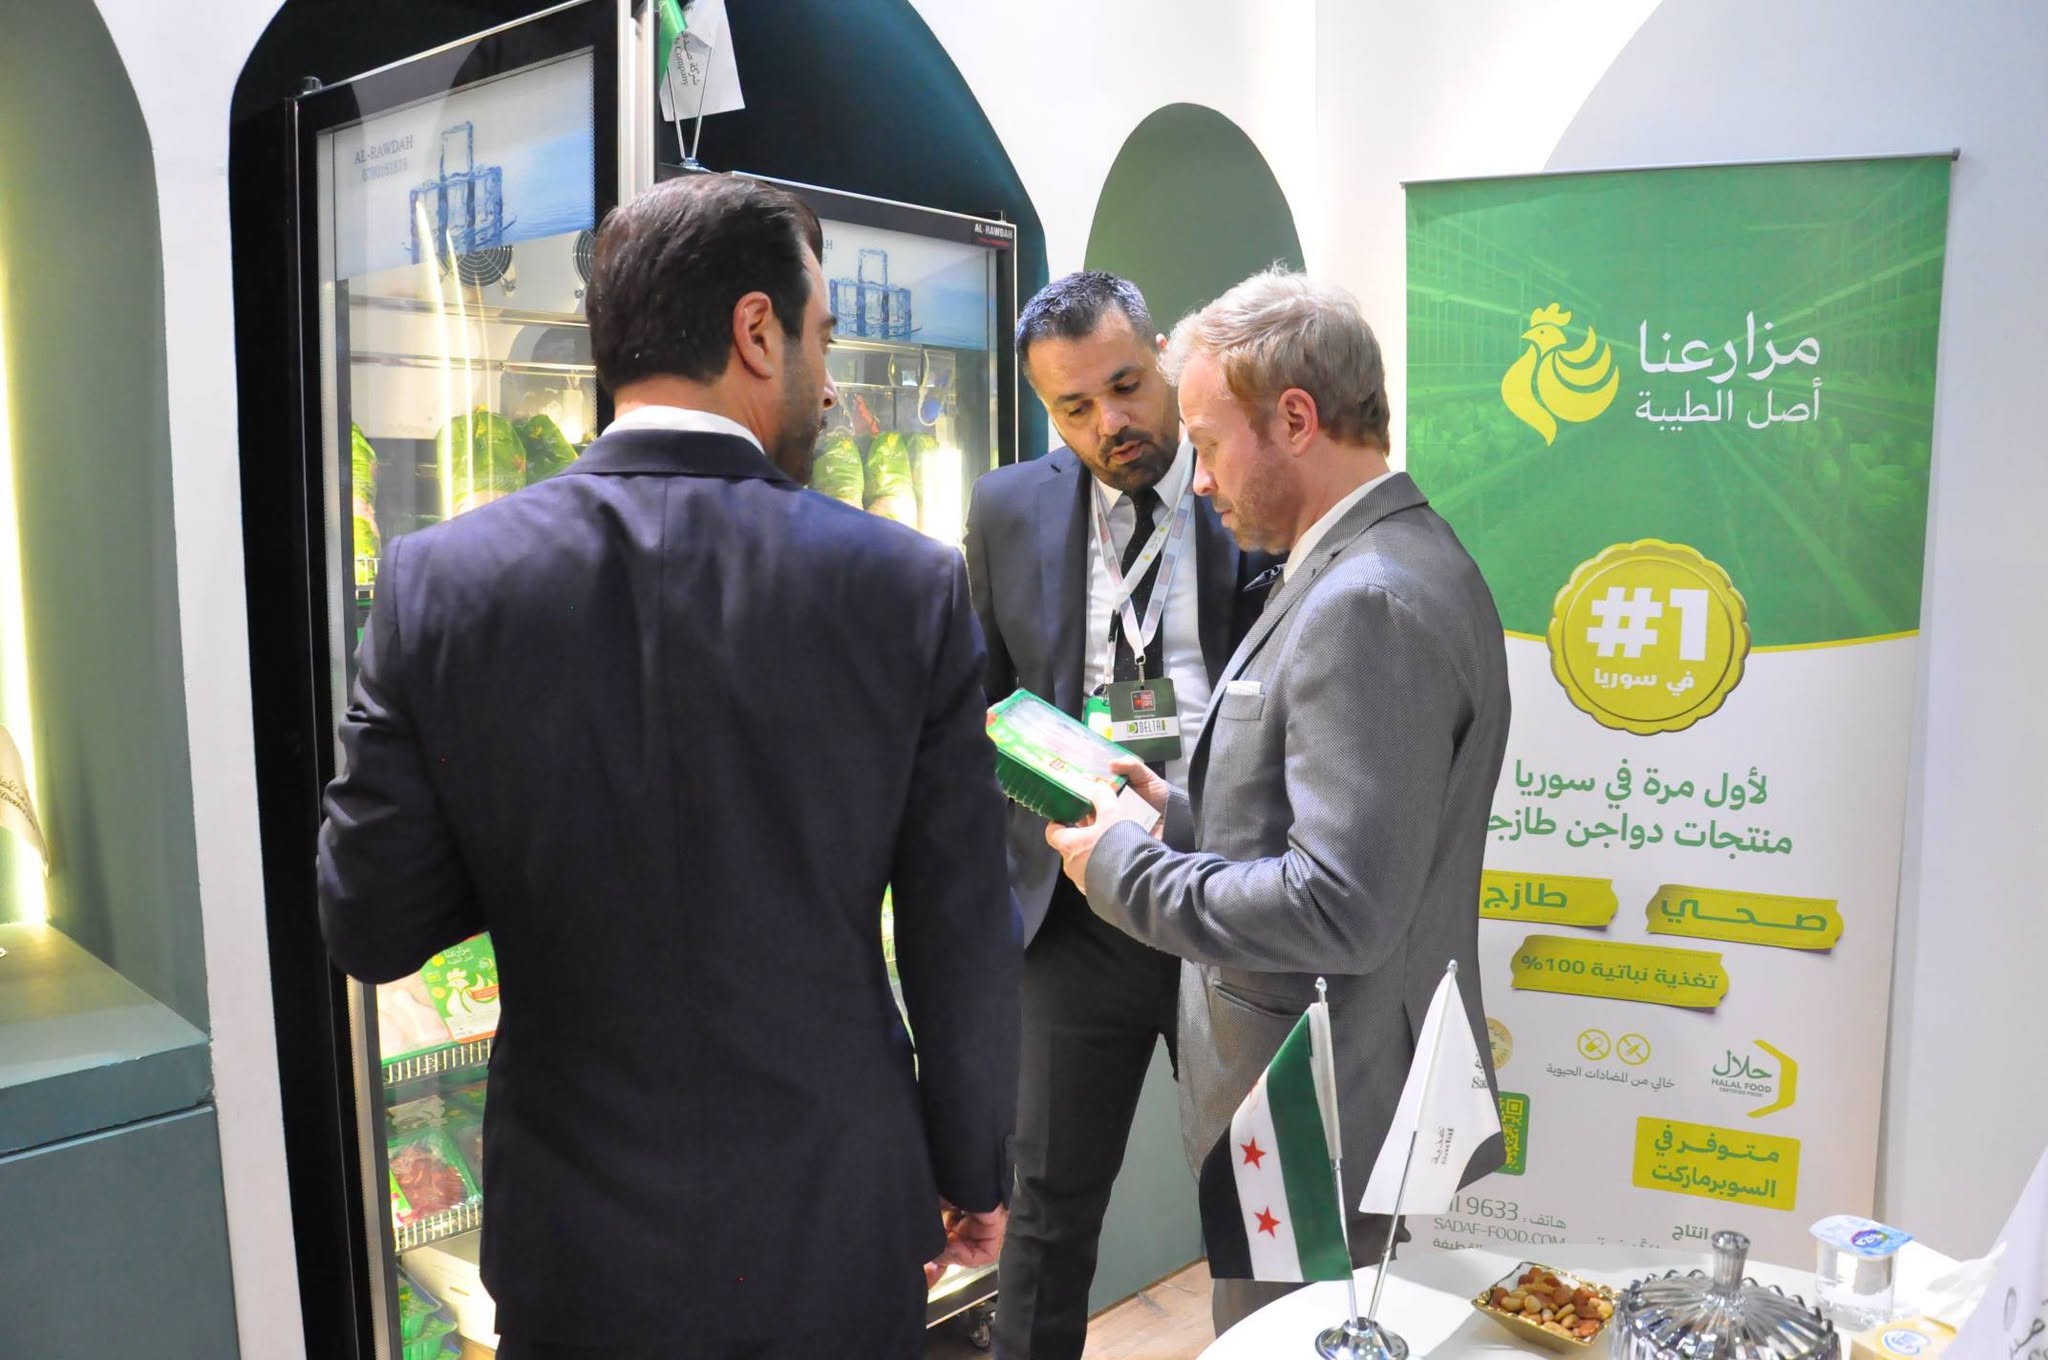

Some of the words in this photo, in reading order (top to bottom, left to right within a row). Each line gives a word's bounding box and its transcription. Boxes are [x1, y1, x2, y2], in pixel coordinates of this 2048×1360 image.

[674, 46, 689, 86] Company
[353, 134, 414, 165] AL-RAWDAH
[1639, 311, 1821, 384] مزارعنا
[1634, 389, 1734, 432] الطيبة
[1746, 377, 1823, 429] أصل
[1586, 586, 1709, 662] #1
[1593, 667, 1658, 689] سوريا
[1666, 670, 1695, 697] في
[1138, 720, 1162, 734] DELTA
[1515, 759, 1596, 799] سوريا
[1605, 758, 1633, 810] في
[1642, 767, 1695, 805] مرة
[1703, 766, 1769, 811] لأول
[1487, 806, 1557, 842] طازج
[1565, 812, 1664, 850] دواجن
[1673, 819, 1793, 860] منتجات
[1483, 881, 1569, 912] طازج
[1660, 897, 1828, 933] صحي
[1590, 960, 1649, 984] نباتية
[1654, 968, 1717, 991] تغذية
[1545, 1063, 1582, 1078] الحيوية
[1584, 1069, 1629, 1084] المضادات
[1712, 1049, 1774, 1079] حلال
[1630, 1078, 1649, 1087] من
[1650, 1077, 1676, 1093] خالي
[1711, 1078, 1743, 1090] HALAL
[1744, 1083, 1772, 1094] FOOD
[1654, 1124, 1673, 1157] في
[1675, 1132, 1780, 1163] متوفر
[1651, 1164, 1777, 1199] السوبرماركت
[1466, 1196, 1519, 1222] 9633
